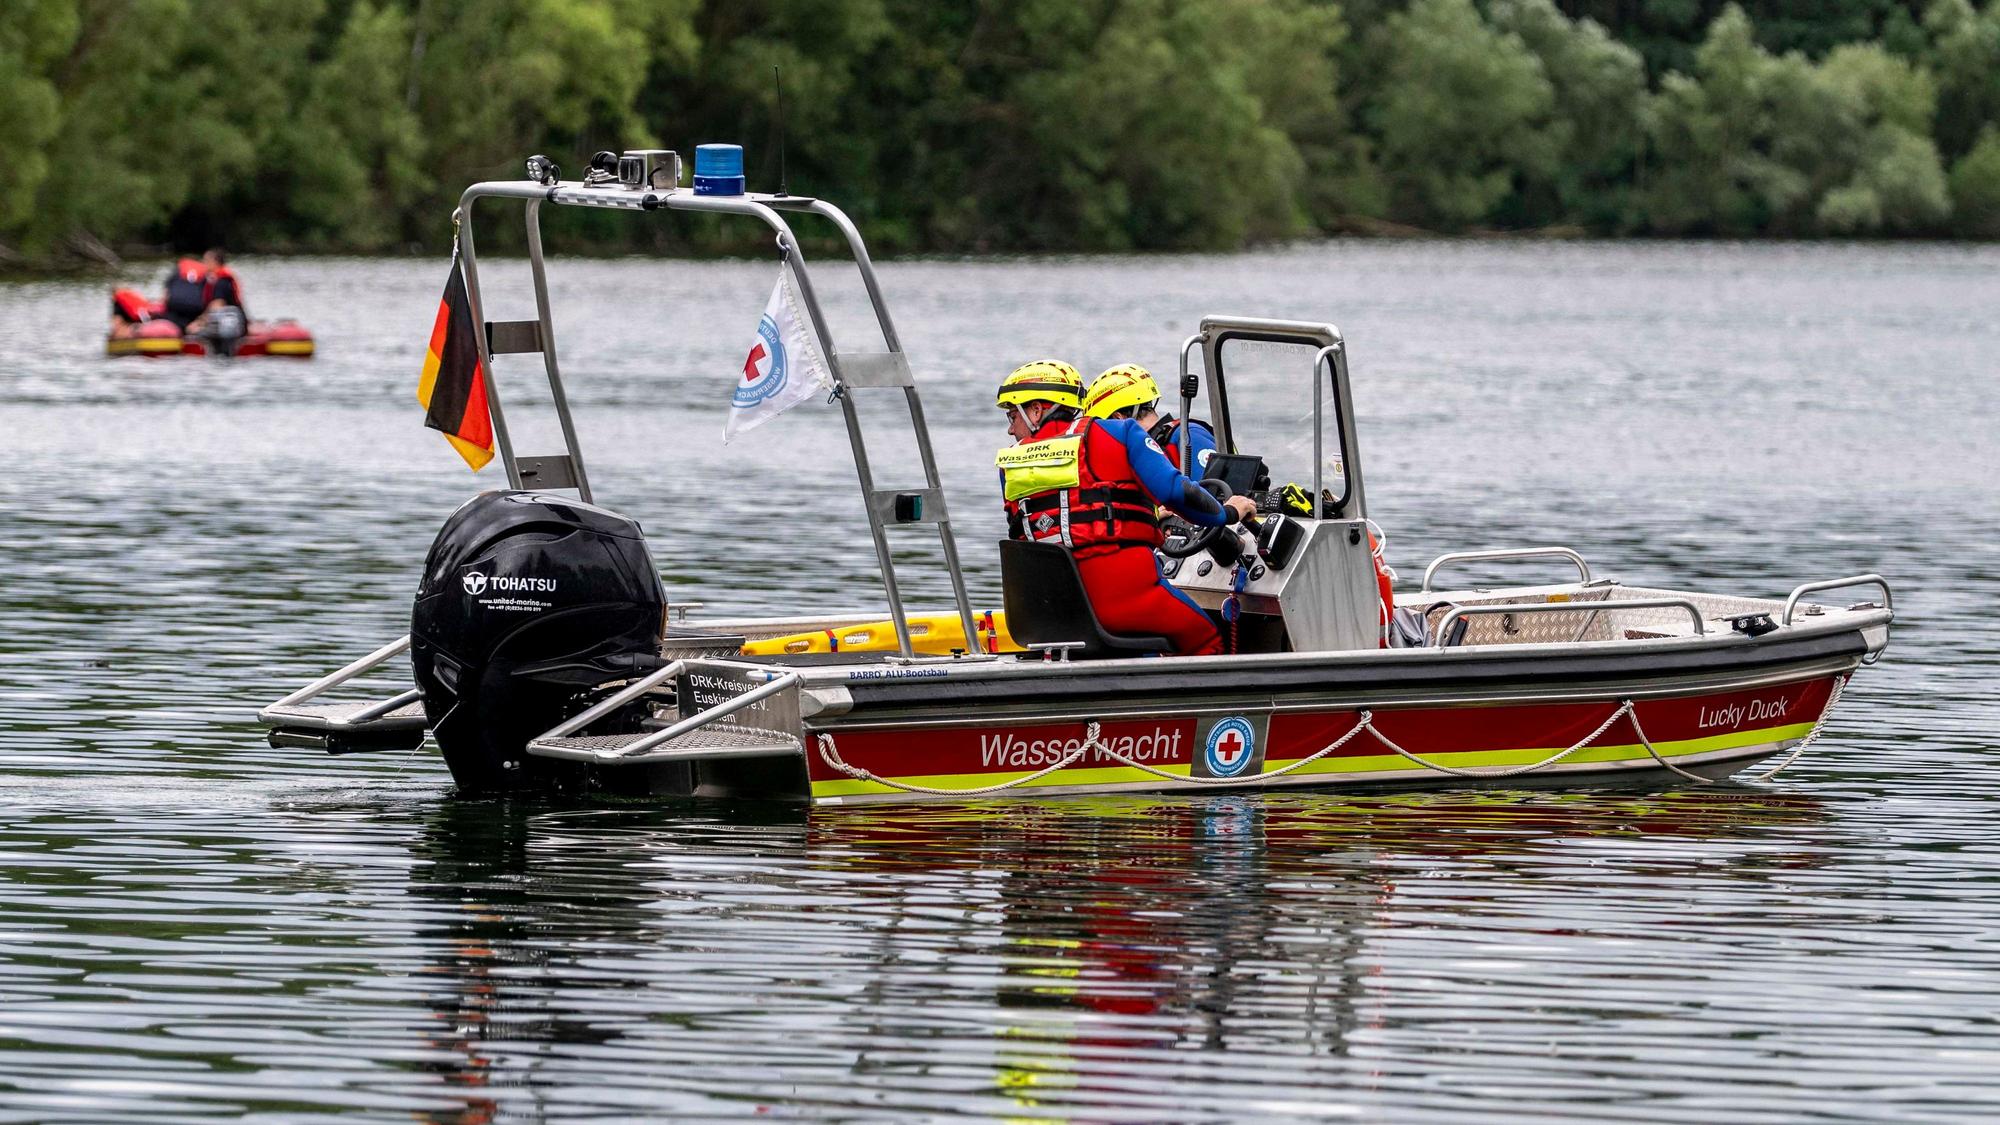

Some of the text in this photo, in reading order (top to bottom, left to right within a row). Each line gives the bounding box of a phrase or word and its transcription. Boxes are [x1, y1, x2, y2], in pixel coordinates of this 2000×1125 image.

[1026, 444, 1051, 453] DRK
[999, 449, 1075, 462] Wasserwacht
[490, 577, 556, 592] TOHATSU
[885, 669, 948, 679] ALU-Bootsbau
[690, 674, 782, 697] DRK-Kreisver
[751, 700, 769, 712] e.V.
[1699, 695, 1788, 729] Lucky Duck
